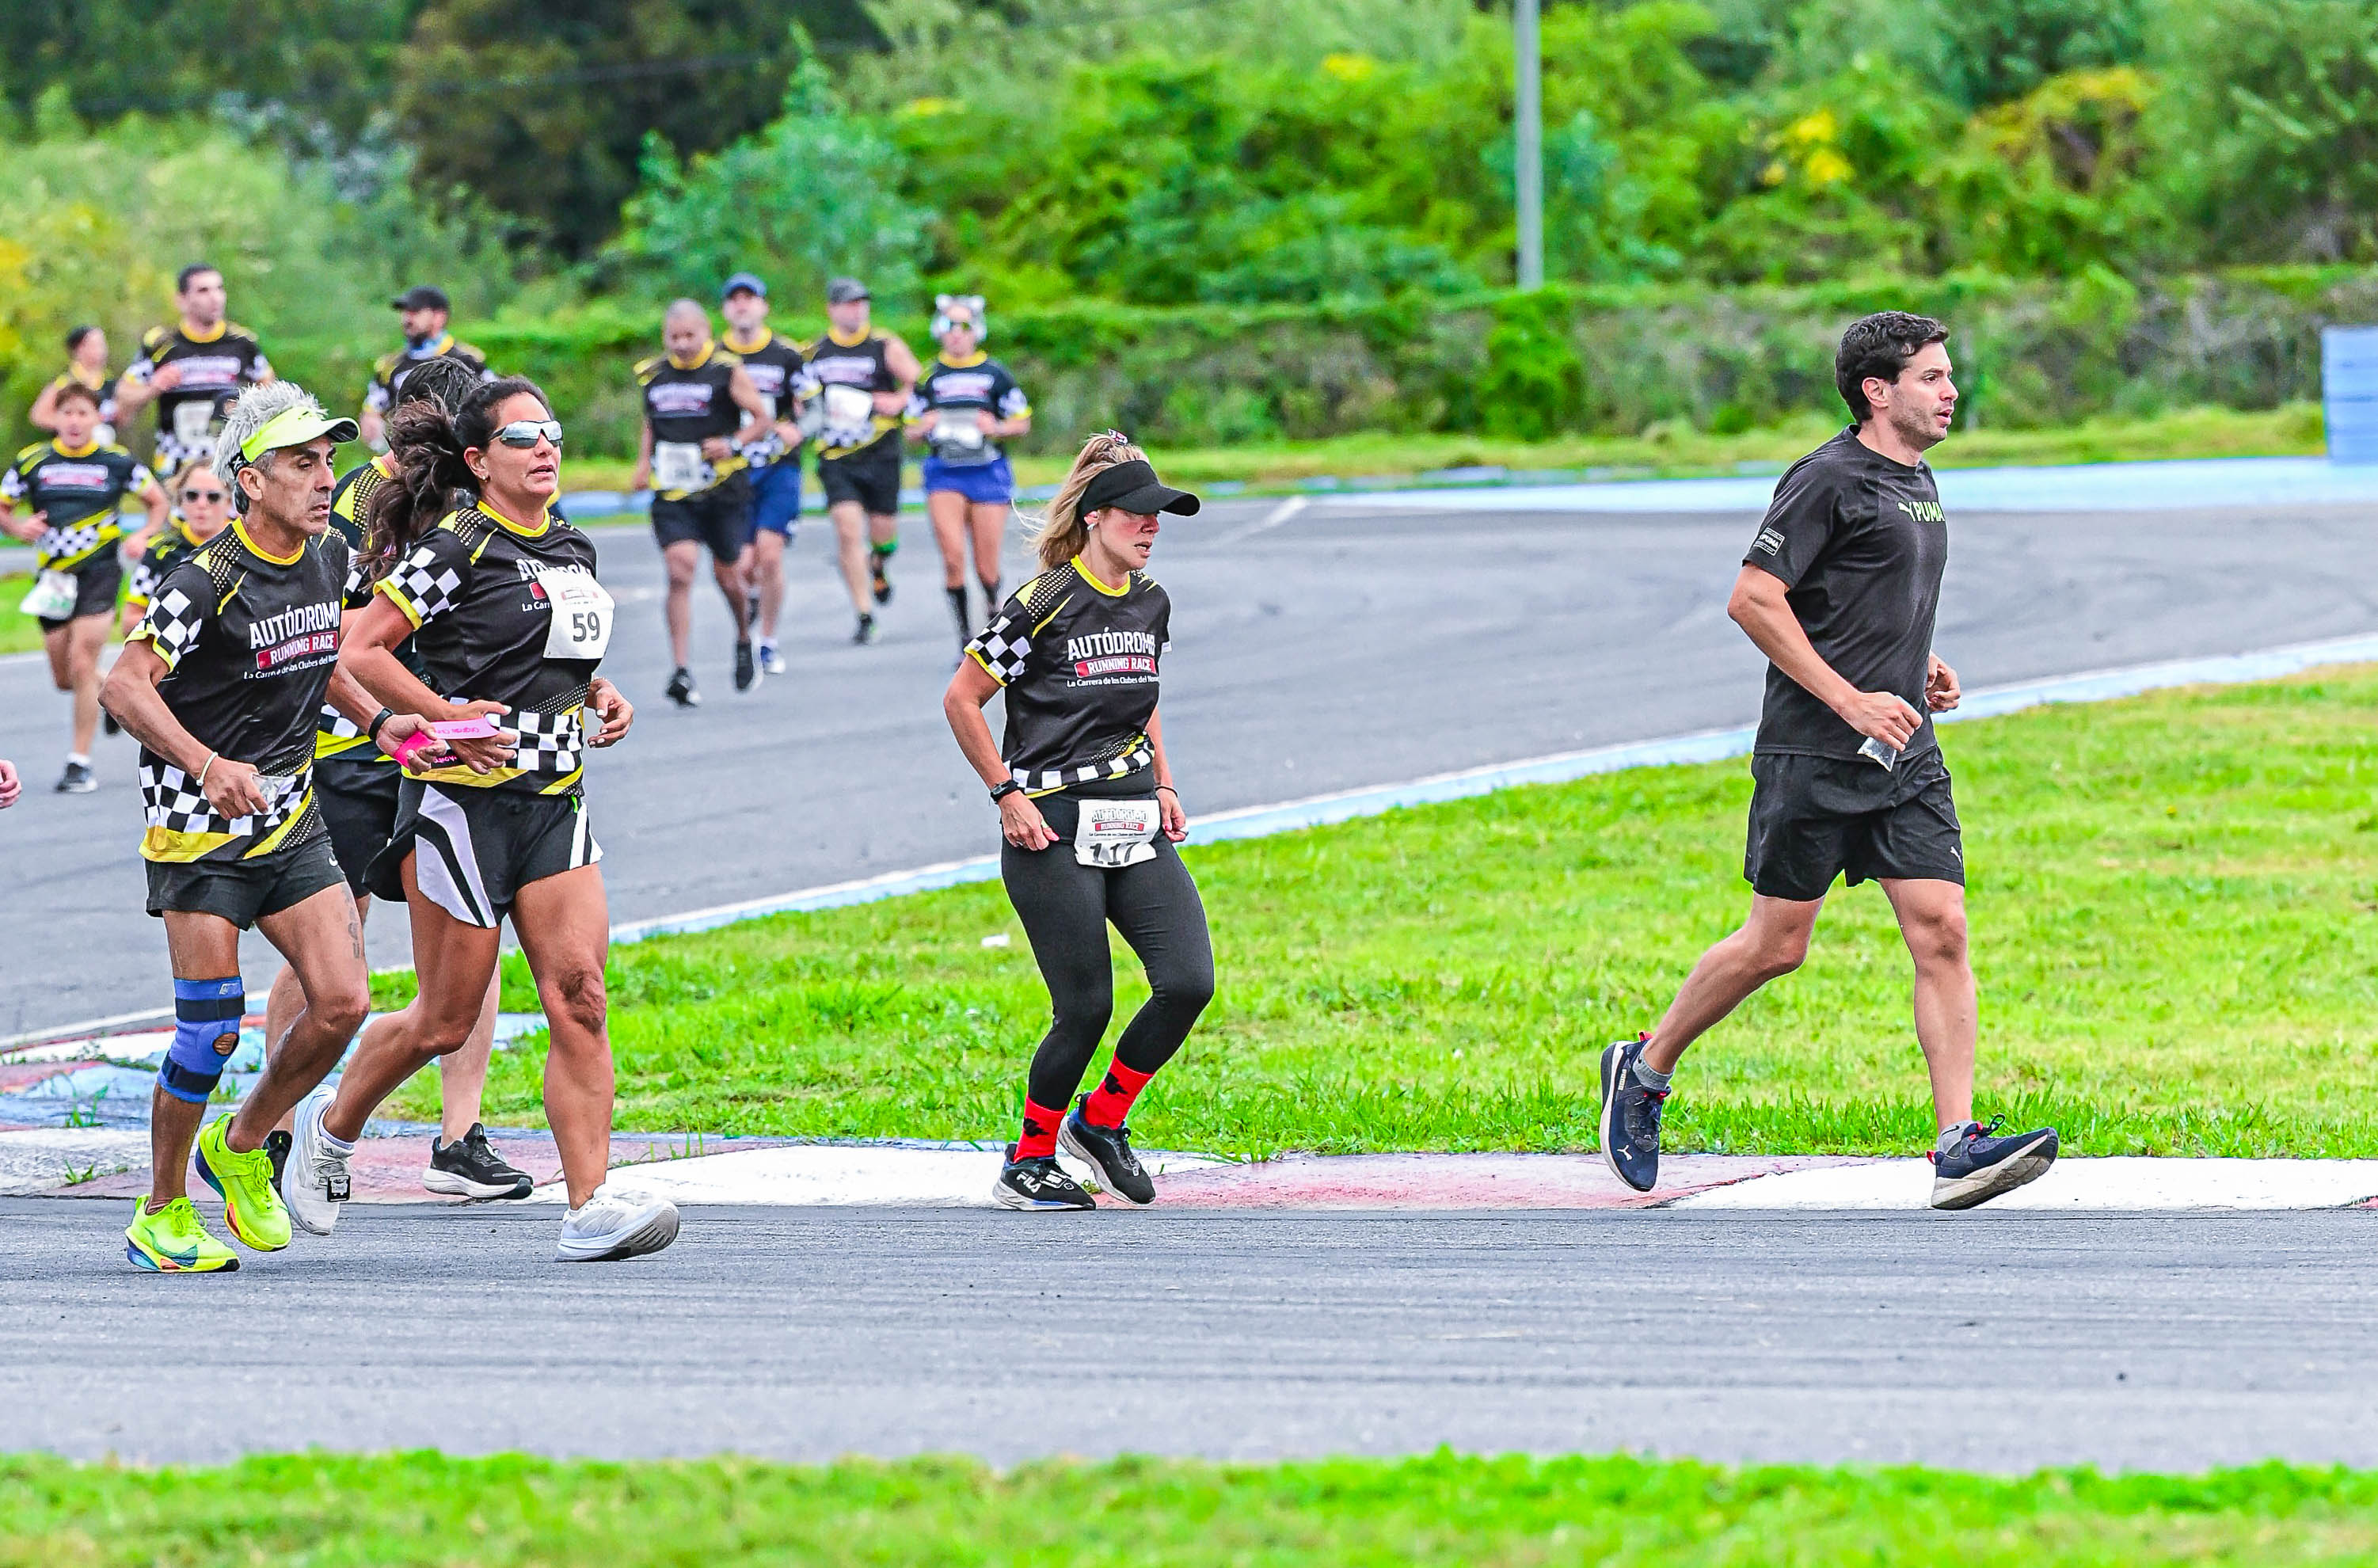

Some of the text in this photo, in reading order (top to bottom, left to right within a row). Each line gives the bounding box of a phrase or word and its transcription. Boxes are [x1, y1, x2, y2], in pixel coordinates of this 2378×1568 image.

[1912, 501, 1945, 522] PUMA
[523, 601, 550, 611] La Carr
[573, 611, 600, 642] 59
[270, 634, 334, 664] RUNNING RACE
[1067, 626, 1155, 661] AUTÓDROMO
[298, 659, 318, 670] Clubes
[319, 656, 328, 664] del
[1086, 657, 1152, 674] RUNNING RACE
[1090, 842, 1141, 866] 117
[1016, 1171, 1041, 1193] FILA
